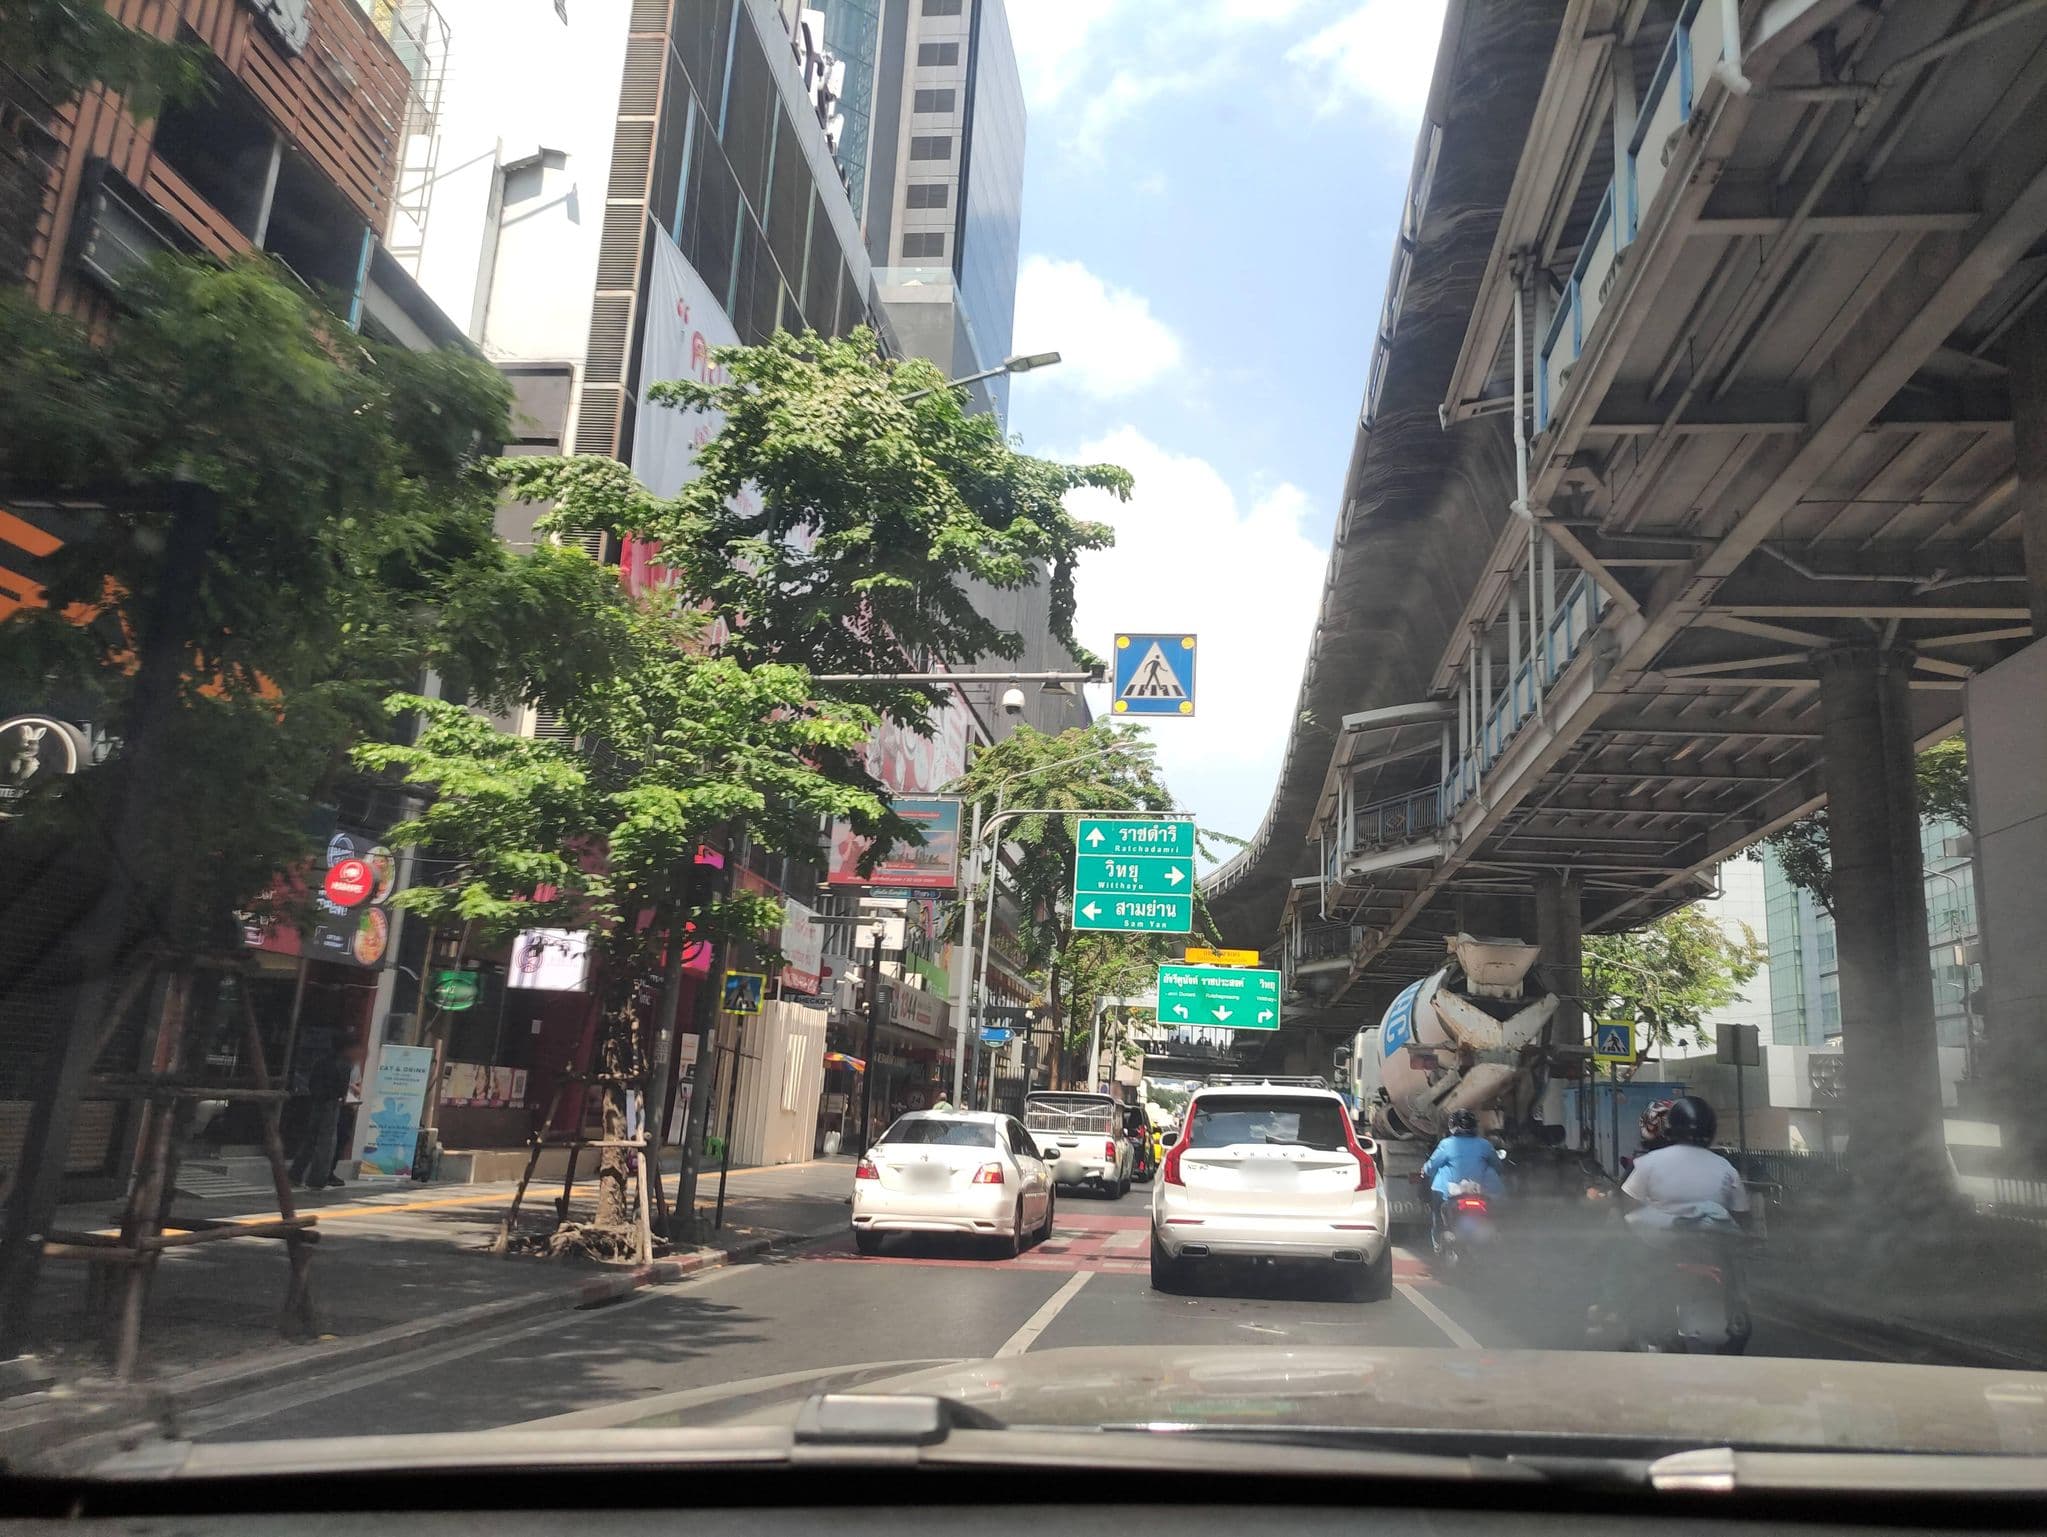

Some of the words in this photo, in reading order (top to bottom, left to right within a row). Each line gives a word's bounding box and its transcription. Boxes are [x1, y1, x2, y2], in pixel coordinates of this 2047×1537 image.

[1119, 824, 1177, 842] ราชดำริ
[1114, 844, 1179, 853] Ratchadamri
[1105, 859, 1139, 883] วิทยุ
[1098, 881, 1144, 891] Witthayu
[1115, 899, 1177, 918] สามย่าน
[1123, 919, 1144, 928] Sam
[1149, 920, 1167, 929] Yan
[1259, 978, 1276, 993] วิทยุ
